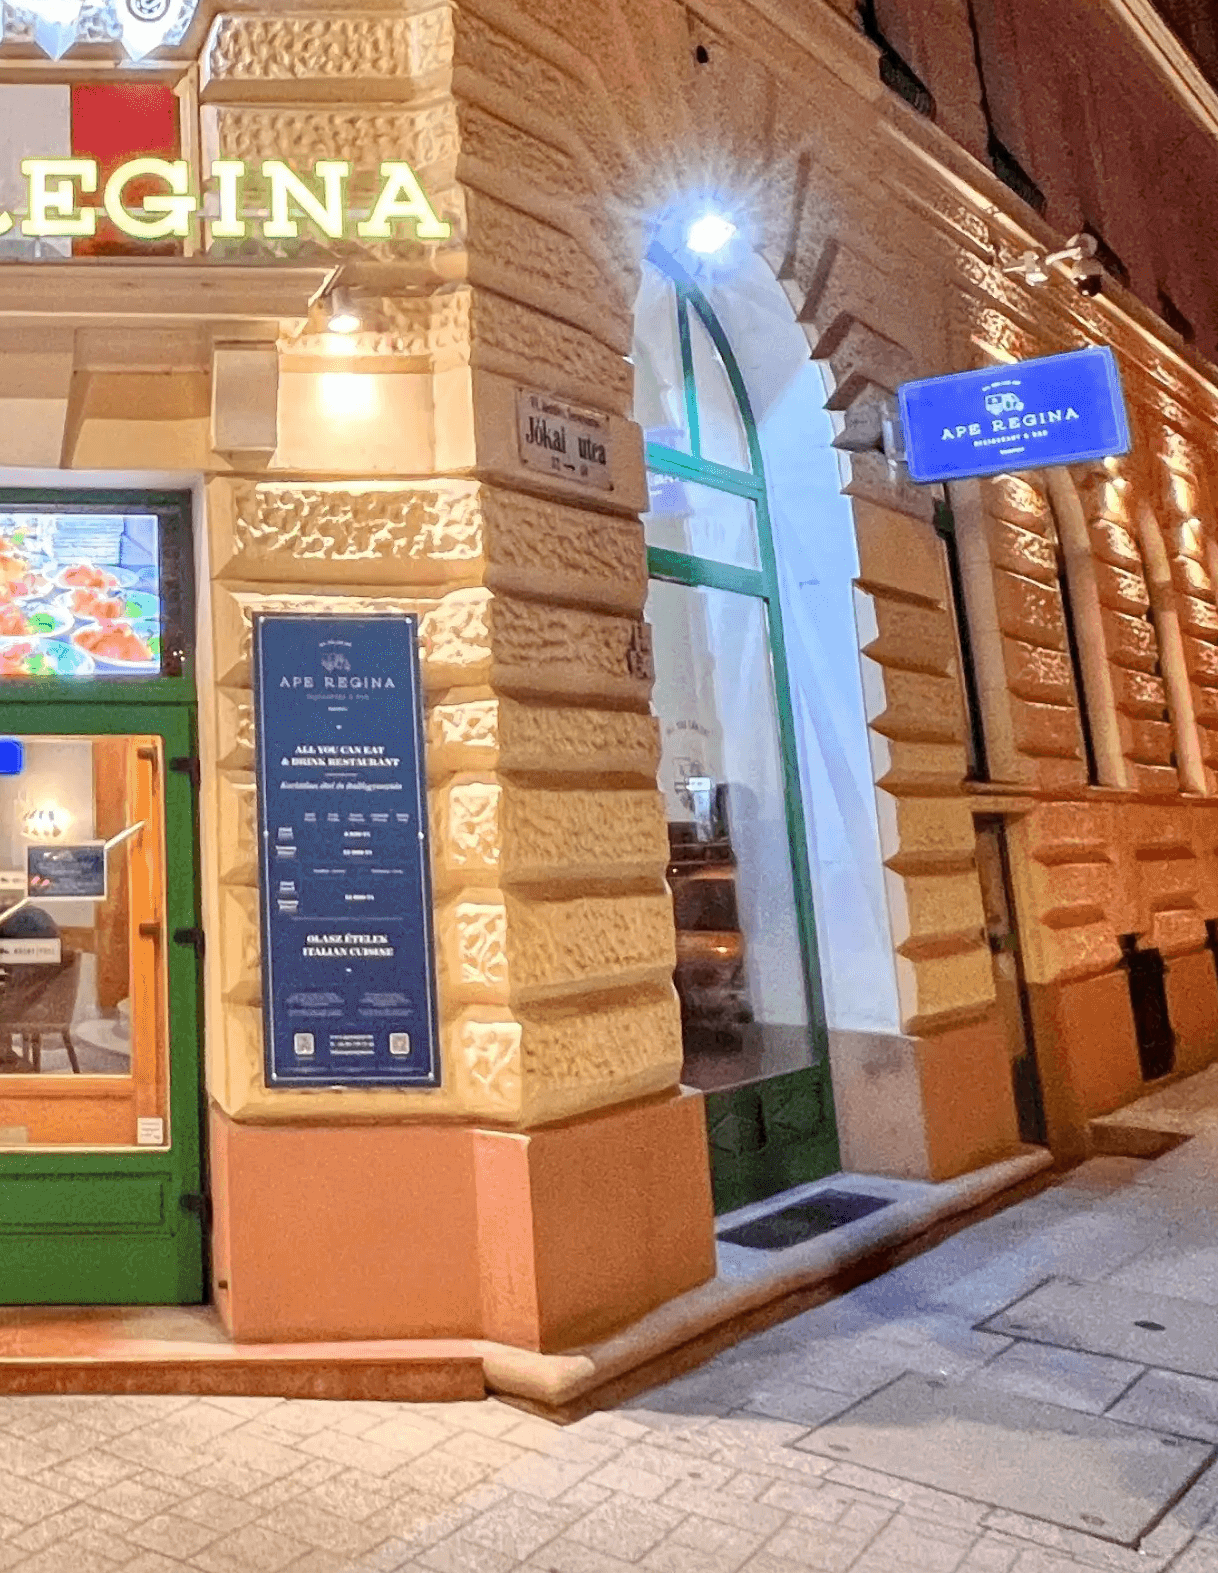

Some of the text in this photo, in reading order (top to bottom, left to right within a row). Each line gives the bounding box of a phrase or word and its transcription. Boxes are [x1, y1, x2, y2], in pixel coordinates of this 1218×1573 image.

[941, 407, 1080, 441] APE REGINA
[280, 676, 396, 689] APE REGINA
[295, 745, 386, 755] ALL YOU CAN EAT
[291, 758, 327, 767] DRINK
[327, 757, 401, 767] RESTAURANT
[306, 934, 343, 944] OLASZ
[302, 947, 394, 957] ITALIAN CUISINE
